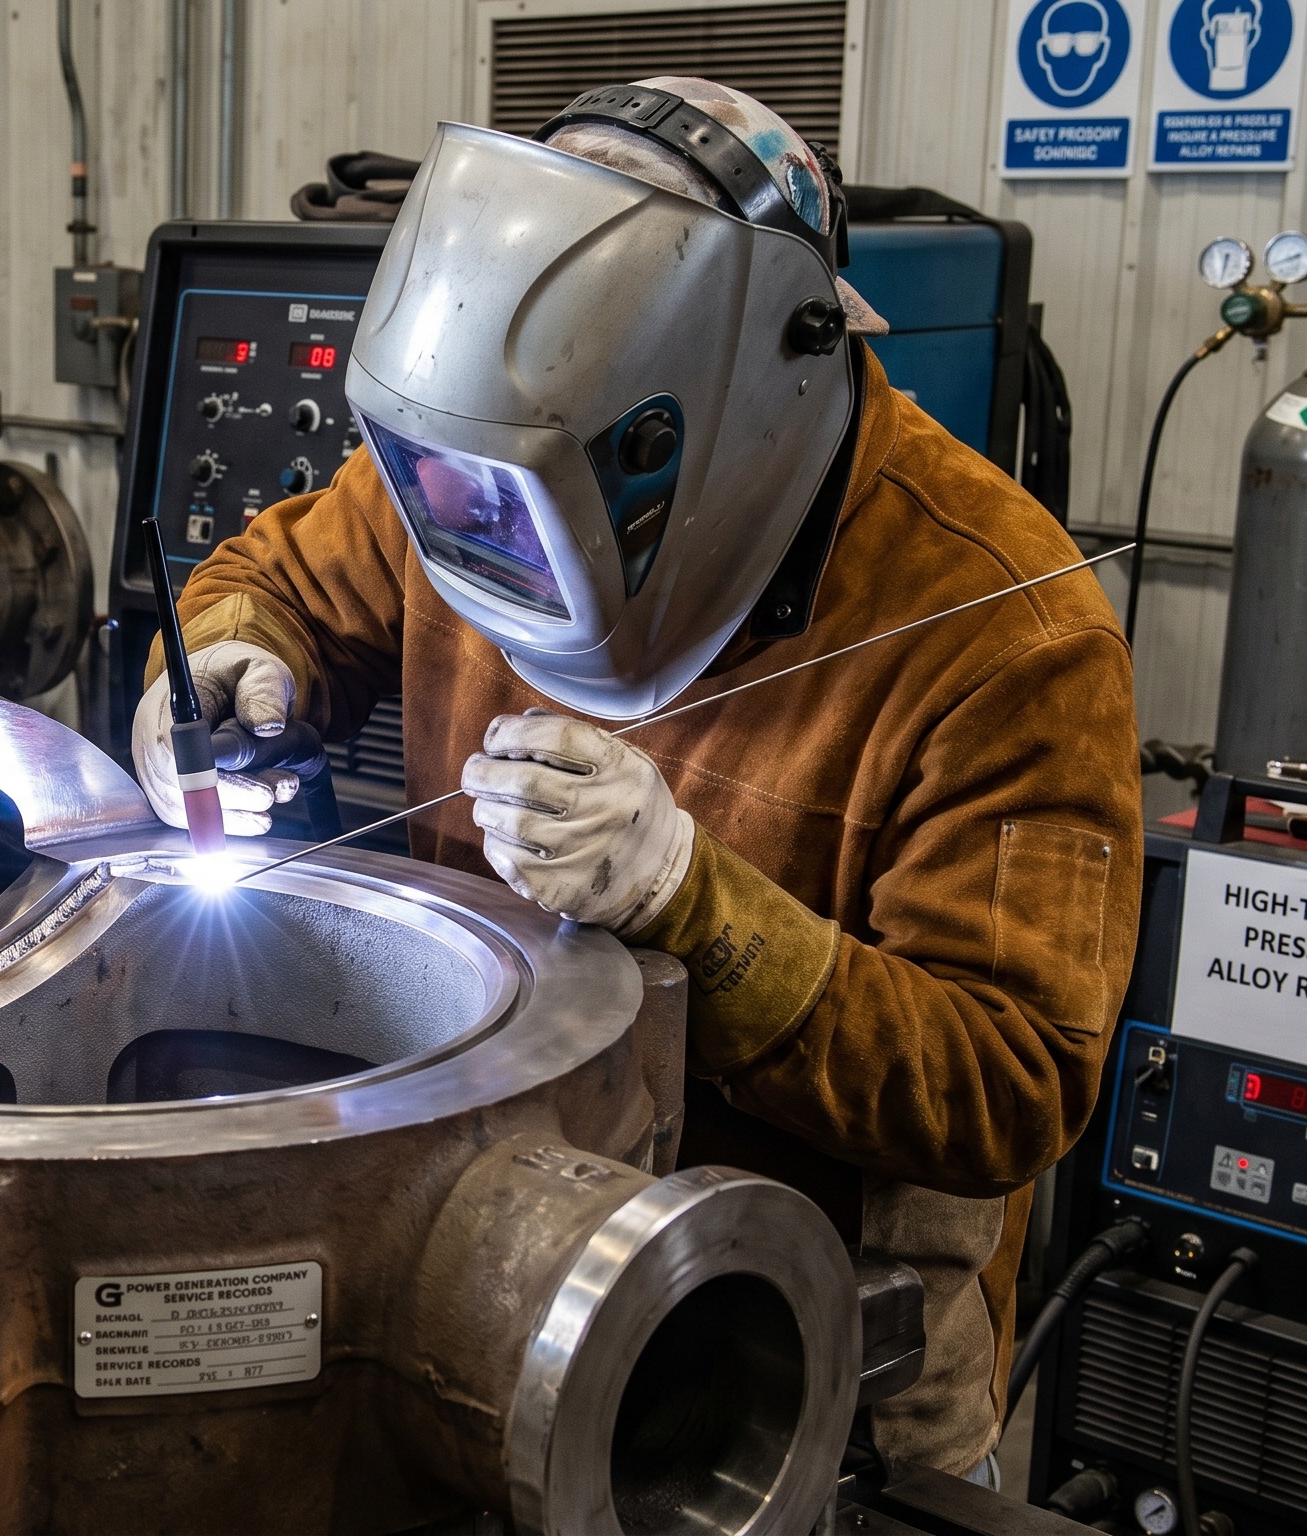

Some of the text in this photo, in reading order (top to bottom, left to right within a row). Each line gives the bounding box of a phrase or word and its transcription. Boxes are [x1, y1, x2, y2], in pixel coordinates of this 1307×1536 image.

[310, 347, 335, 367] 08
[1244, 926, 1307, 959] PRES
[1207, 957, 1288, 993] ALLOY
[126, 1270, 308, 1293] POWER GENERATION COMPANY
[164, 1286, 273, 1304] SERVICE RECORDS
[96, 1358, 201, 1371] SERVICE RECORDS
